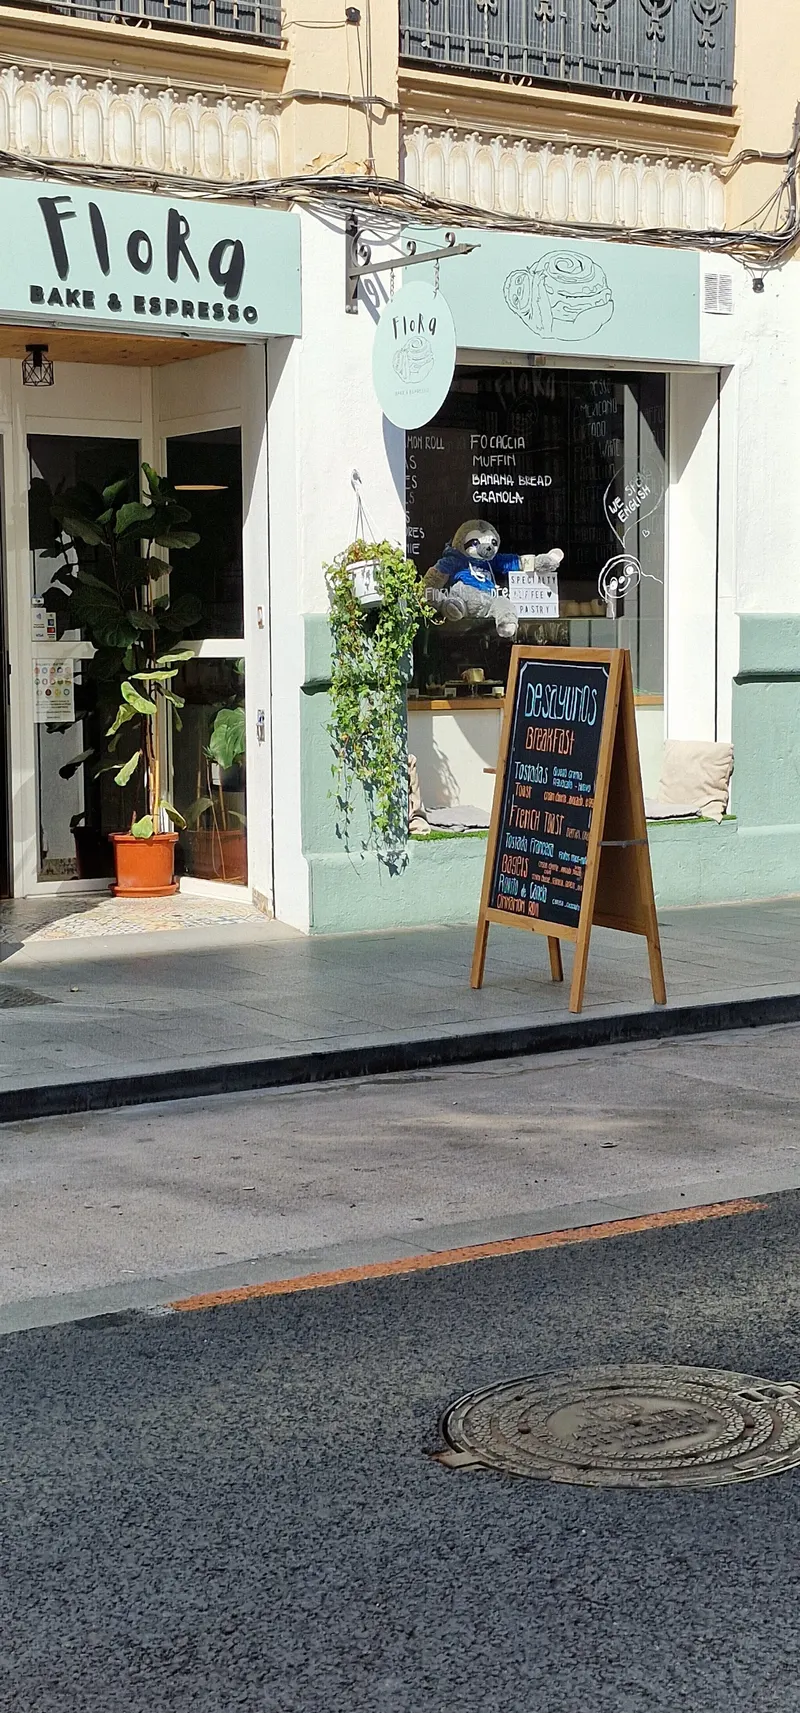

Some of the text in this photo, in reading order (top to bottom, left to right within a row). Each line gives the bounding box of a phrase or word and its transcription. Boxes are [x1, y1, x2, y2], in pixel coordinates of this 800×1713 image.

[29, 284, 259, 325] BAKE & ESPRESSO
[425, 435, 445, 450] ROLL
[472, 453, 516, 468] MUFFIN
[471, 473, 553, 487] BANANA BREAD
[472, 490, 524, 504] GRANOLA
[617, 484, 651, 523] ENGLISH
[608, 496, 625, 514] WE
[511, 575, 556, 585] SPECIALTY
[519, 605, 549, 614] PASTRY
